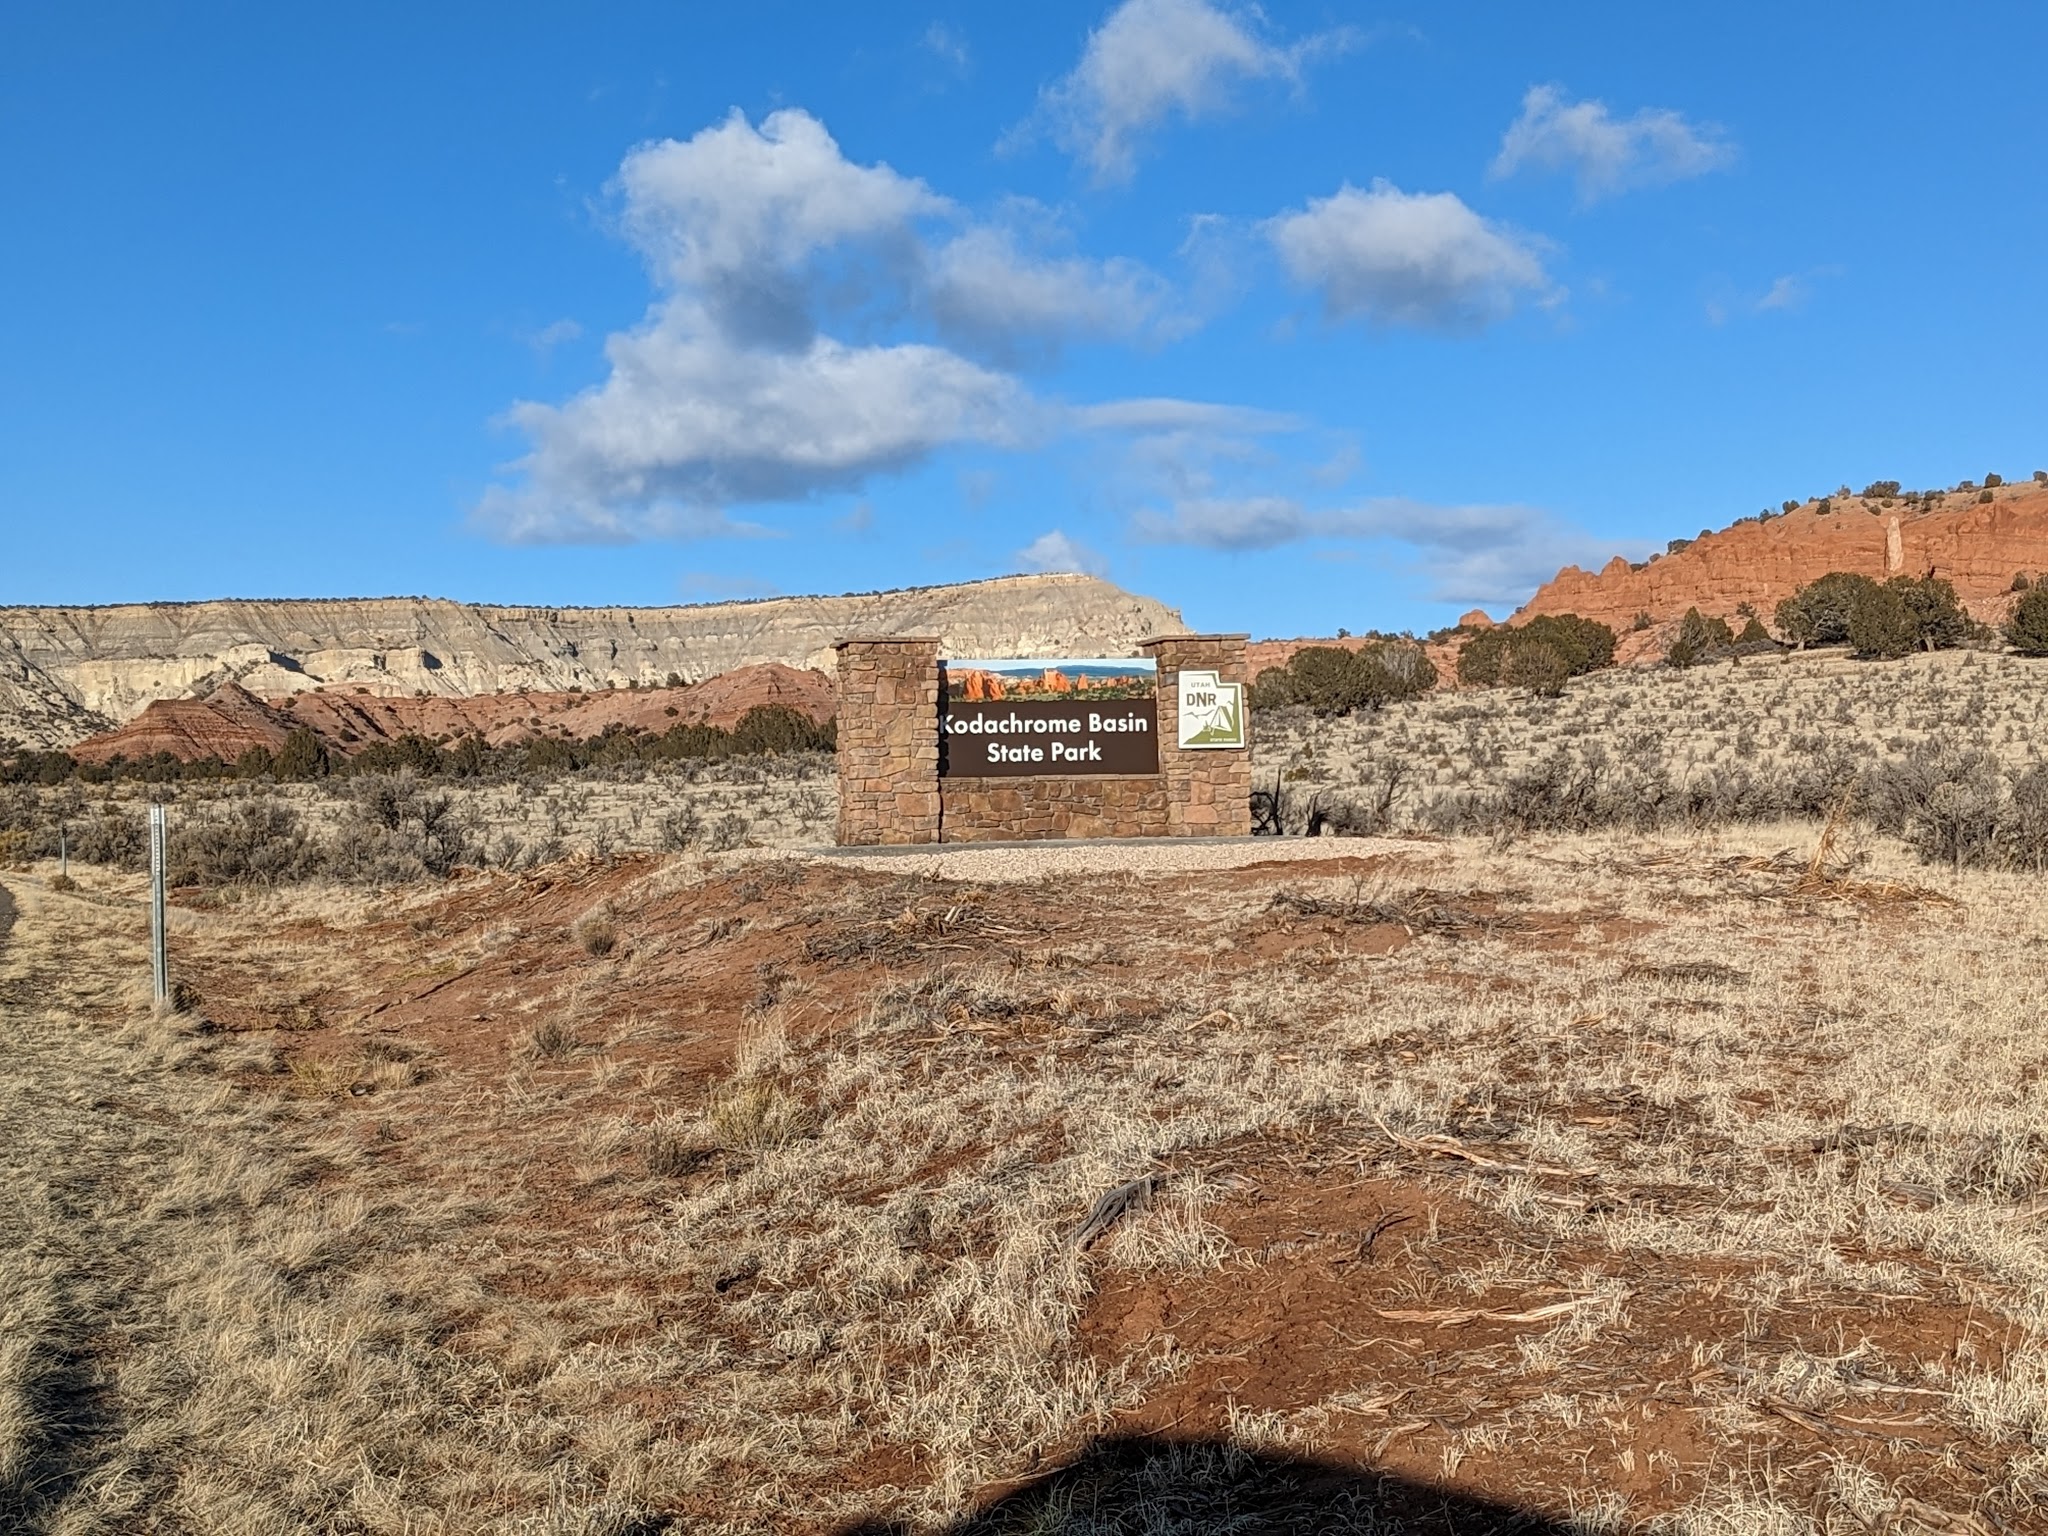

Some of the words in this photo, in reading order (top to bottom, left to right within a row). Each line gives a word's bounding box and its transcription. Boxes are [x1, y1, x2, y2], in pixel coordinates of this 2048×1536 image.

[1186, 692, 1217, 707] DNR
[940, 712, 1081, 734] Kodachrome
[1088, 712, 1148, 732] Basin
[986, 742, 1044, 762] State
[1051, 740, 1102, 761] Park
